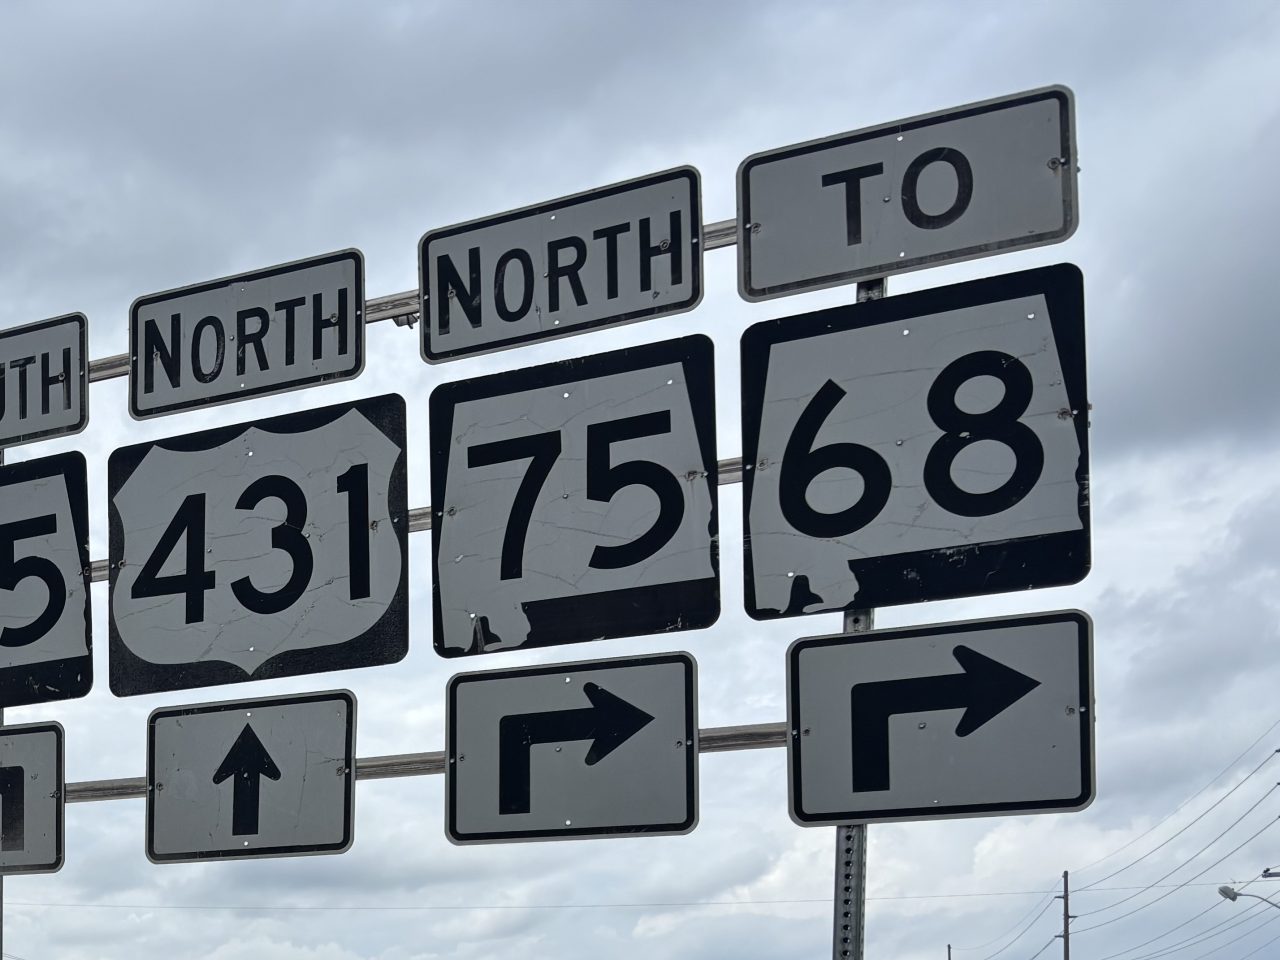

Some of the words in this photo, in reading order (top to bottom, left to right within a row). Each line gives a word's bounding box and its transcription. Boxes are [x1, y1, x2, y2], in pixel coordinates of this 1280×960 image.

[822, 147, 973, 246] TO
[144, 288, 347, 394] NORTH
[437, 210, 682, 335] NORTH
[468, 410, 684, 580] 75
[779, 350, 1044, 538] 68
[131, 463, 370, 624] 431
